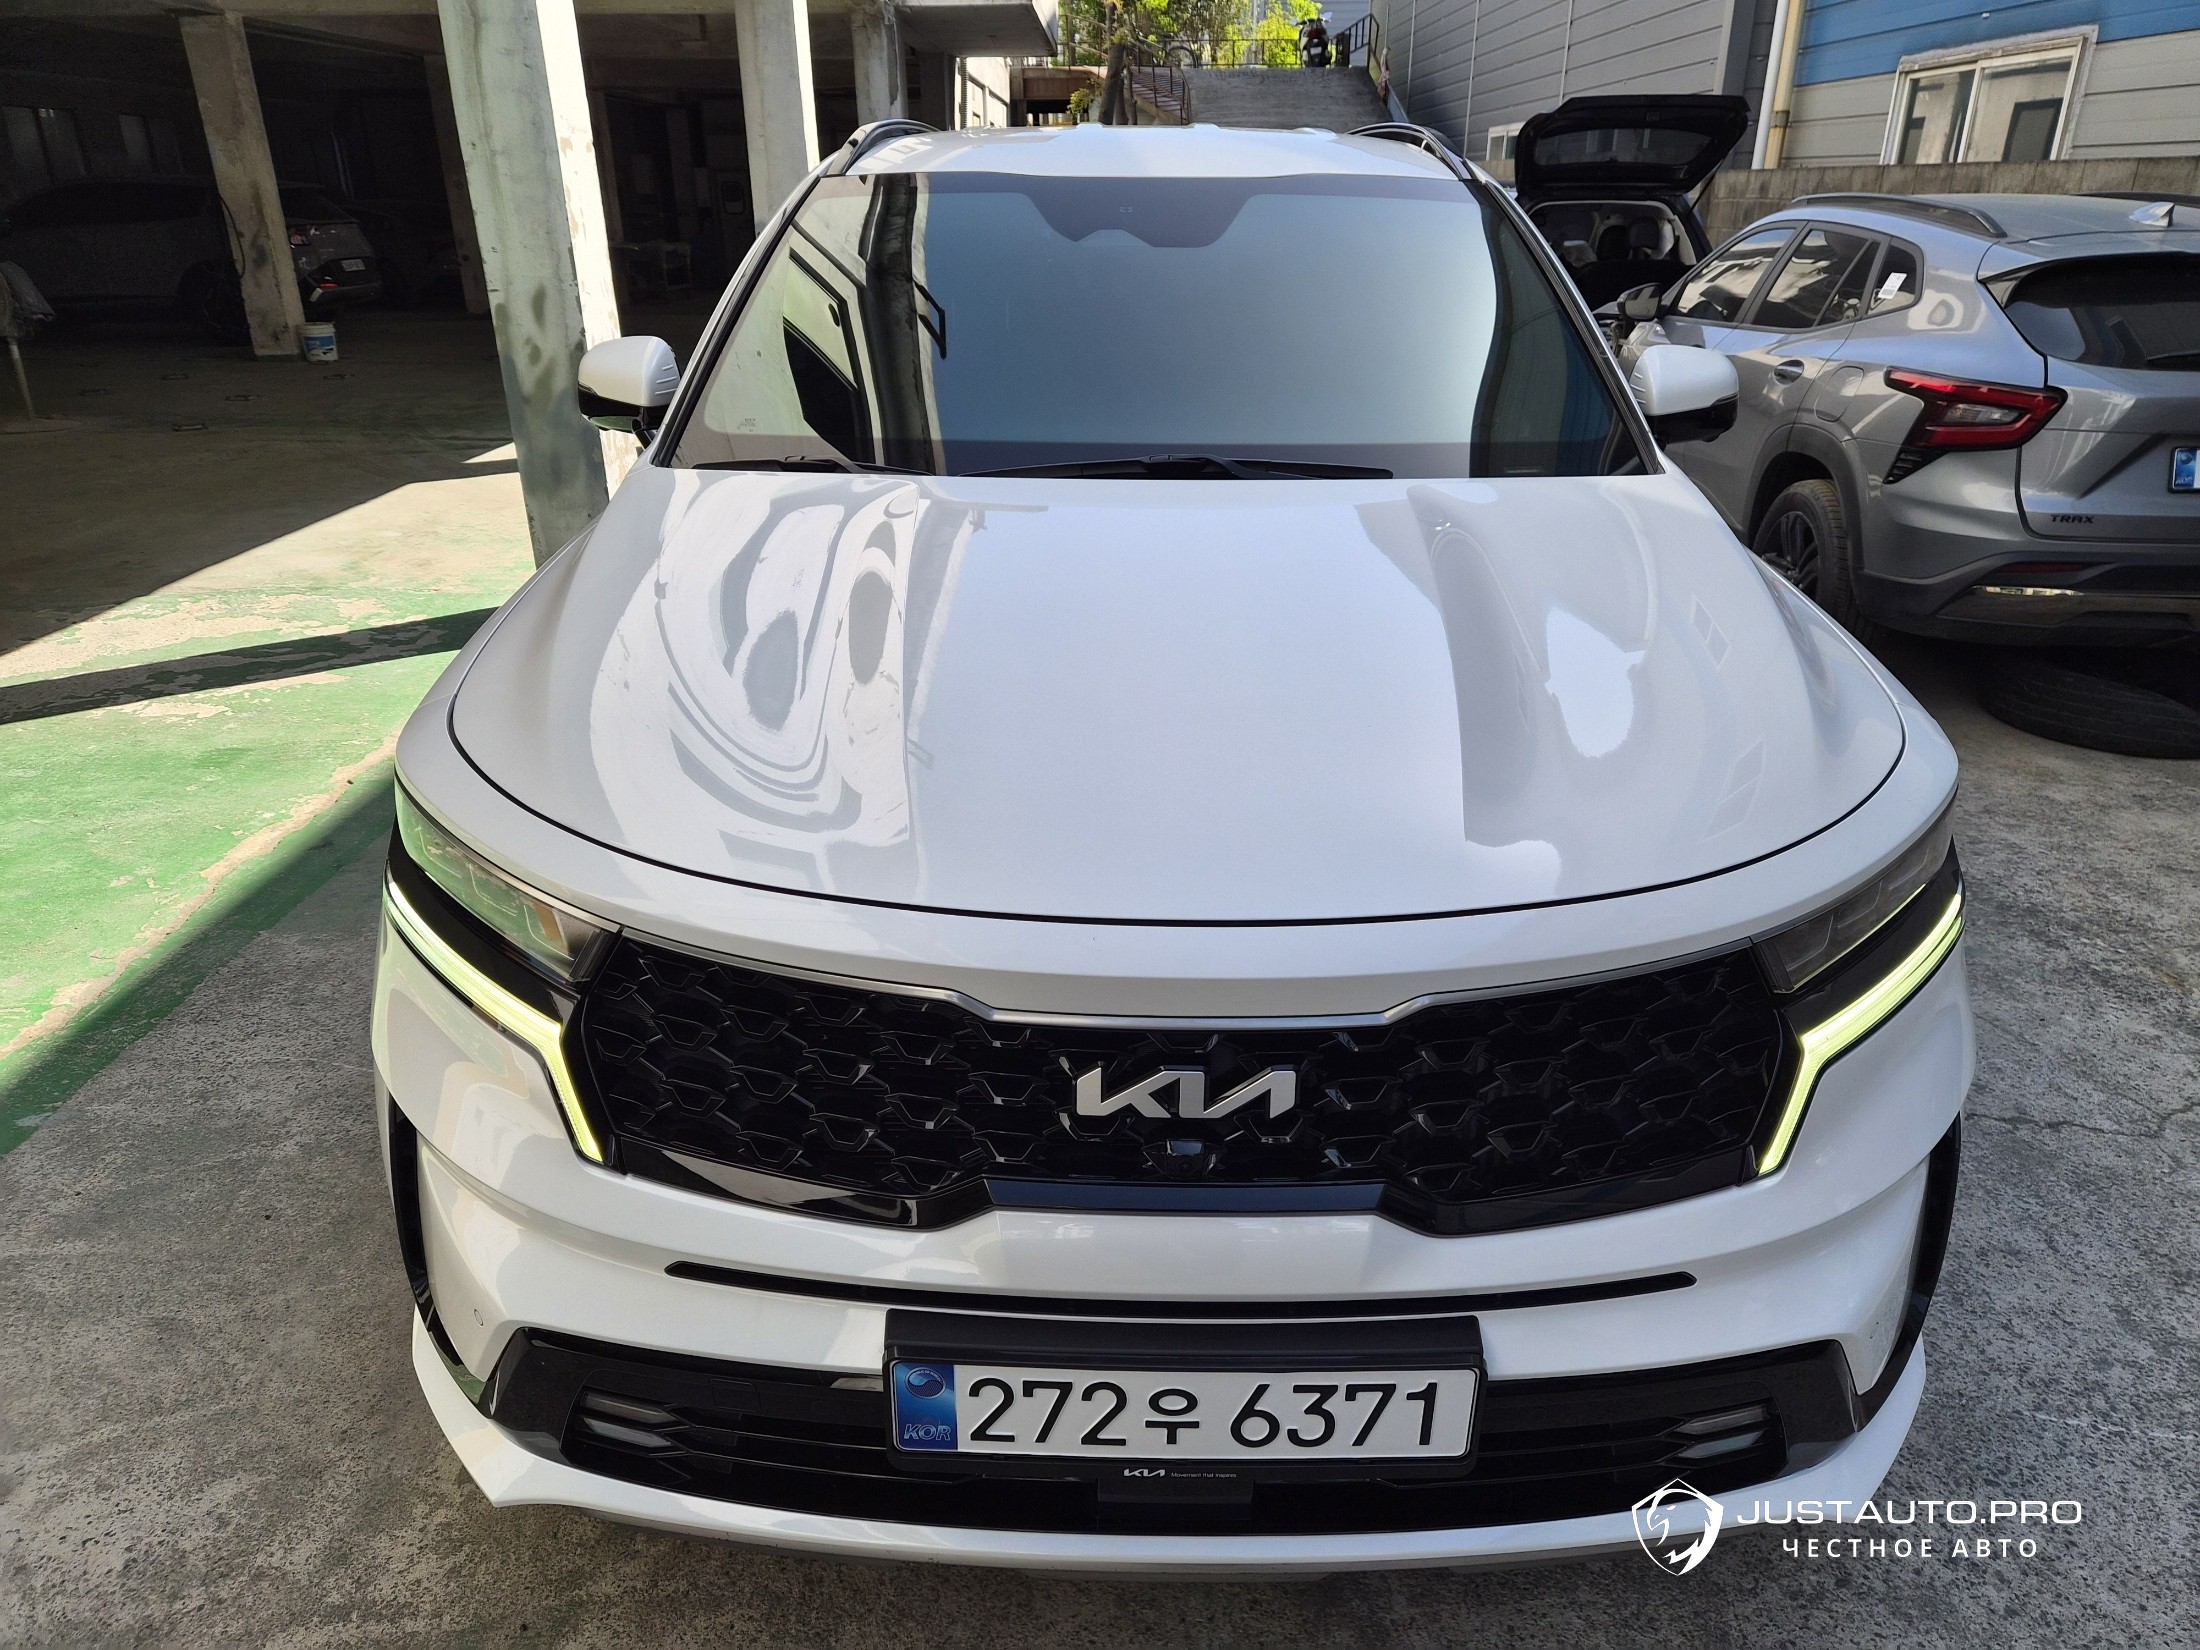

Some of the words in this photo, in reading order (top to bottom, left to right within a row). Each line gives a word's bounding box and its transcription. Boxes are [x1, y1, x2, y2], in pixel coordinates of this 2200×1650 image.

[2051, 514, 2094, 524] TRAX
[1076, 1067, 1297, 1119] KIA
[968, 1377, 1201, 1447] 272우
[1230, 1382, 1439, 1448] 6371
[904, 1424, 952, 1441] KOR
[1123, 1468, 1166, 1477] KIA
